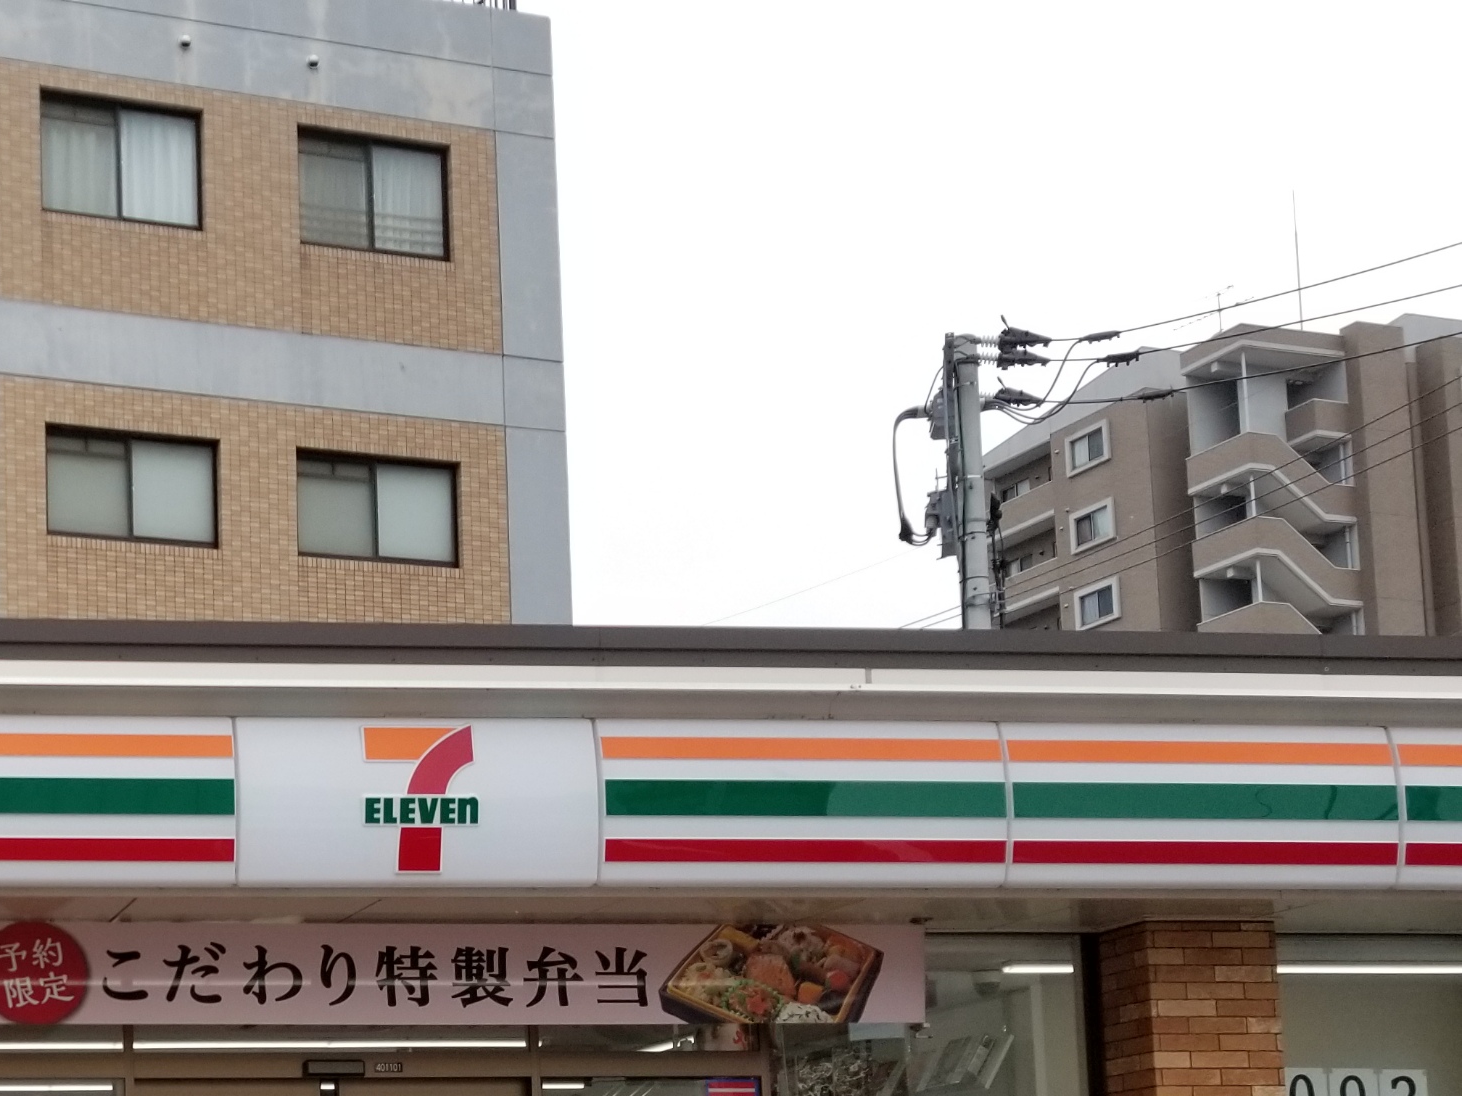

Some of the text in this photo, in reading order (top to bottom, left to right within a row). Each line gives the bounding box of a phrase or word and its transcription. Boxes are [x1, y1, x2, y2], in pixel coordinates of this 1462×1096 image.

[363, 725, 474, 872] 7
[3, 970, 75, 1009] 限定
[101, 942, 649, 1008] こだわり特製弁当
